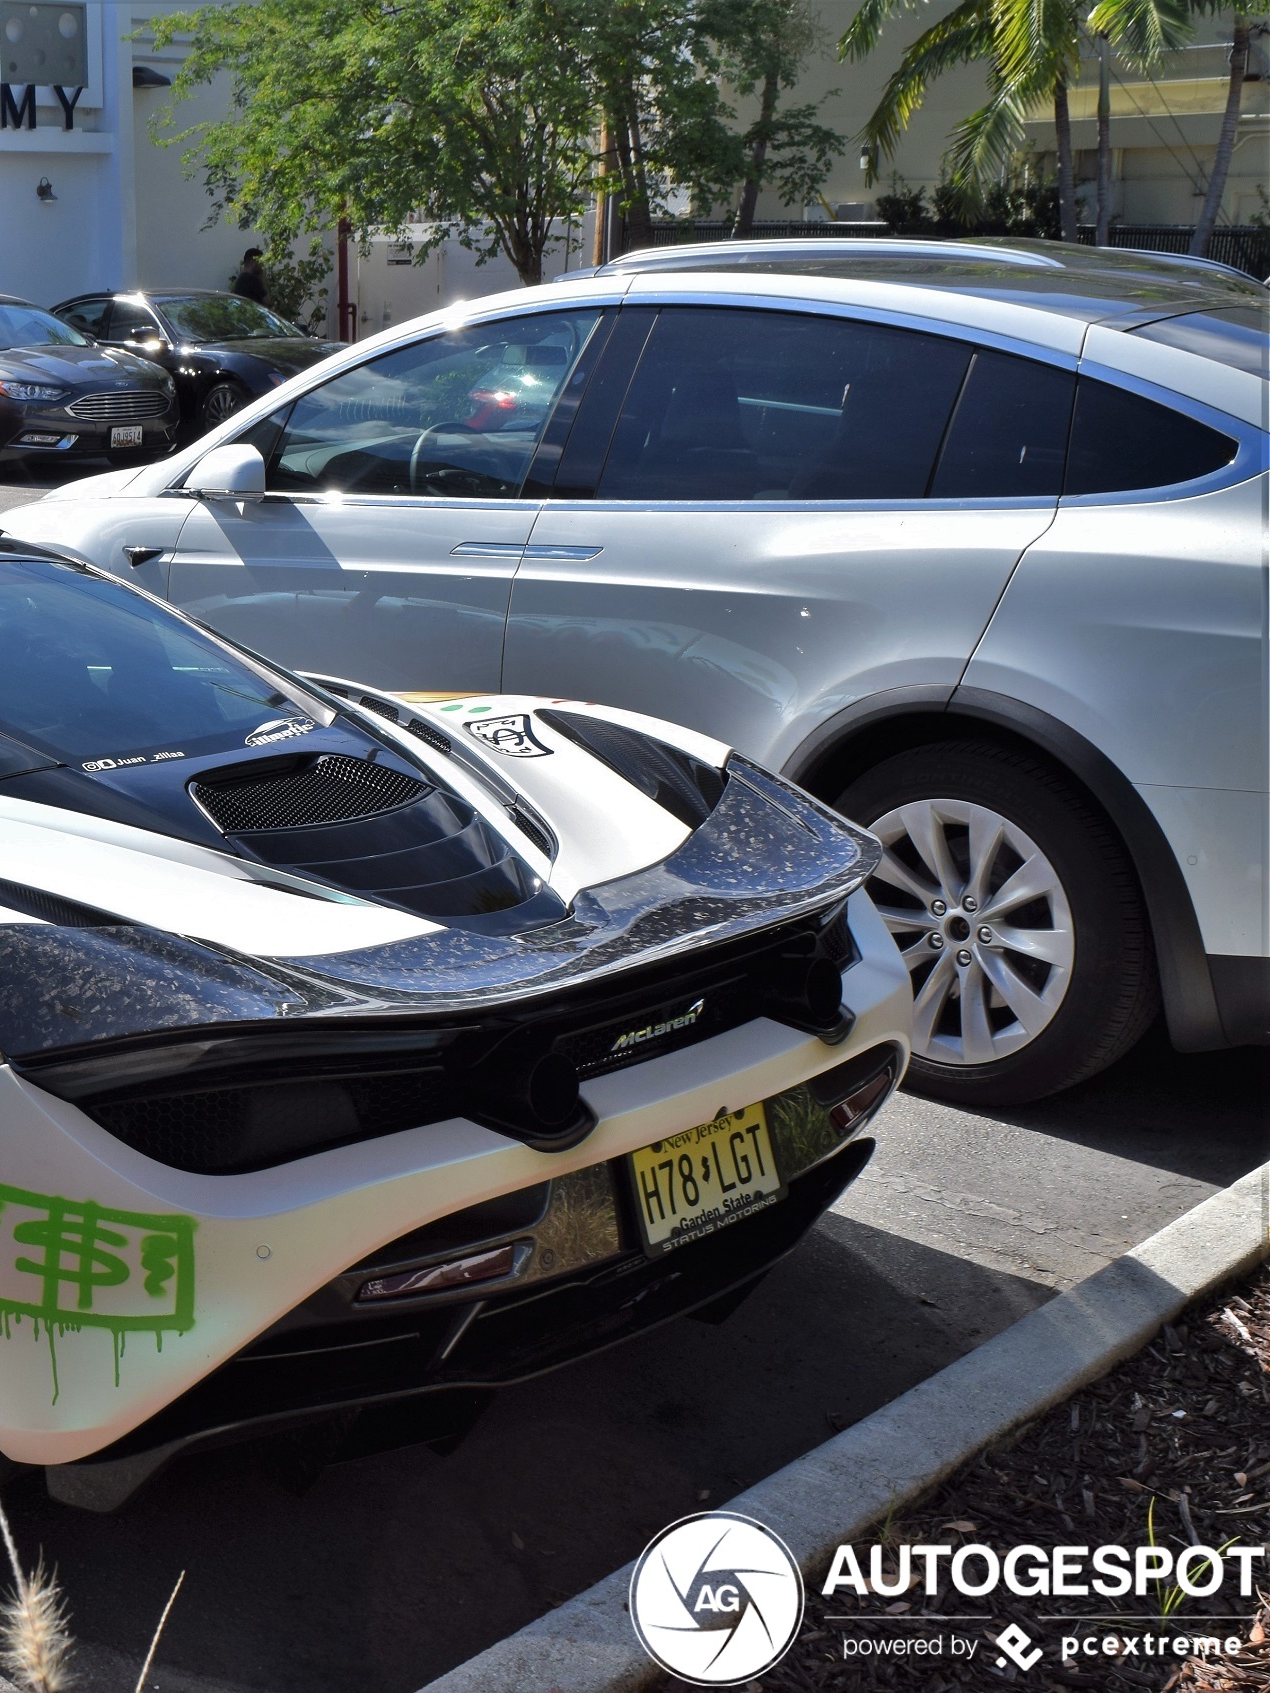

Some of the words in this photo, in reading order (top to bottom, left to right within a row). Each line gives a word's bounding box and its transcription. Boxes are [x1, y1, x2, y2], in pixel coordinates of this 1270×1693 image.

[116, 756, 147, 766] Juan
[611, 1012, 697, 1051] McLaren
[662, 1131, 693, 1154] New
[694, 1115, 734, 1145] Jersey
[662, 1223, 714, 1252] STATUS
[716, 1194, 777, 1229] MOTORING
[680, 1206, 721, 1231] Garden
[722, 1191, 752, 1213] State
